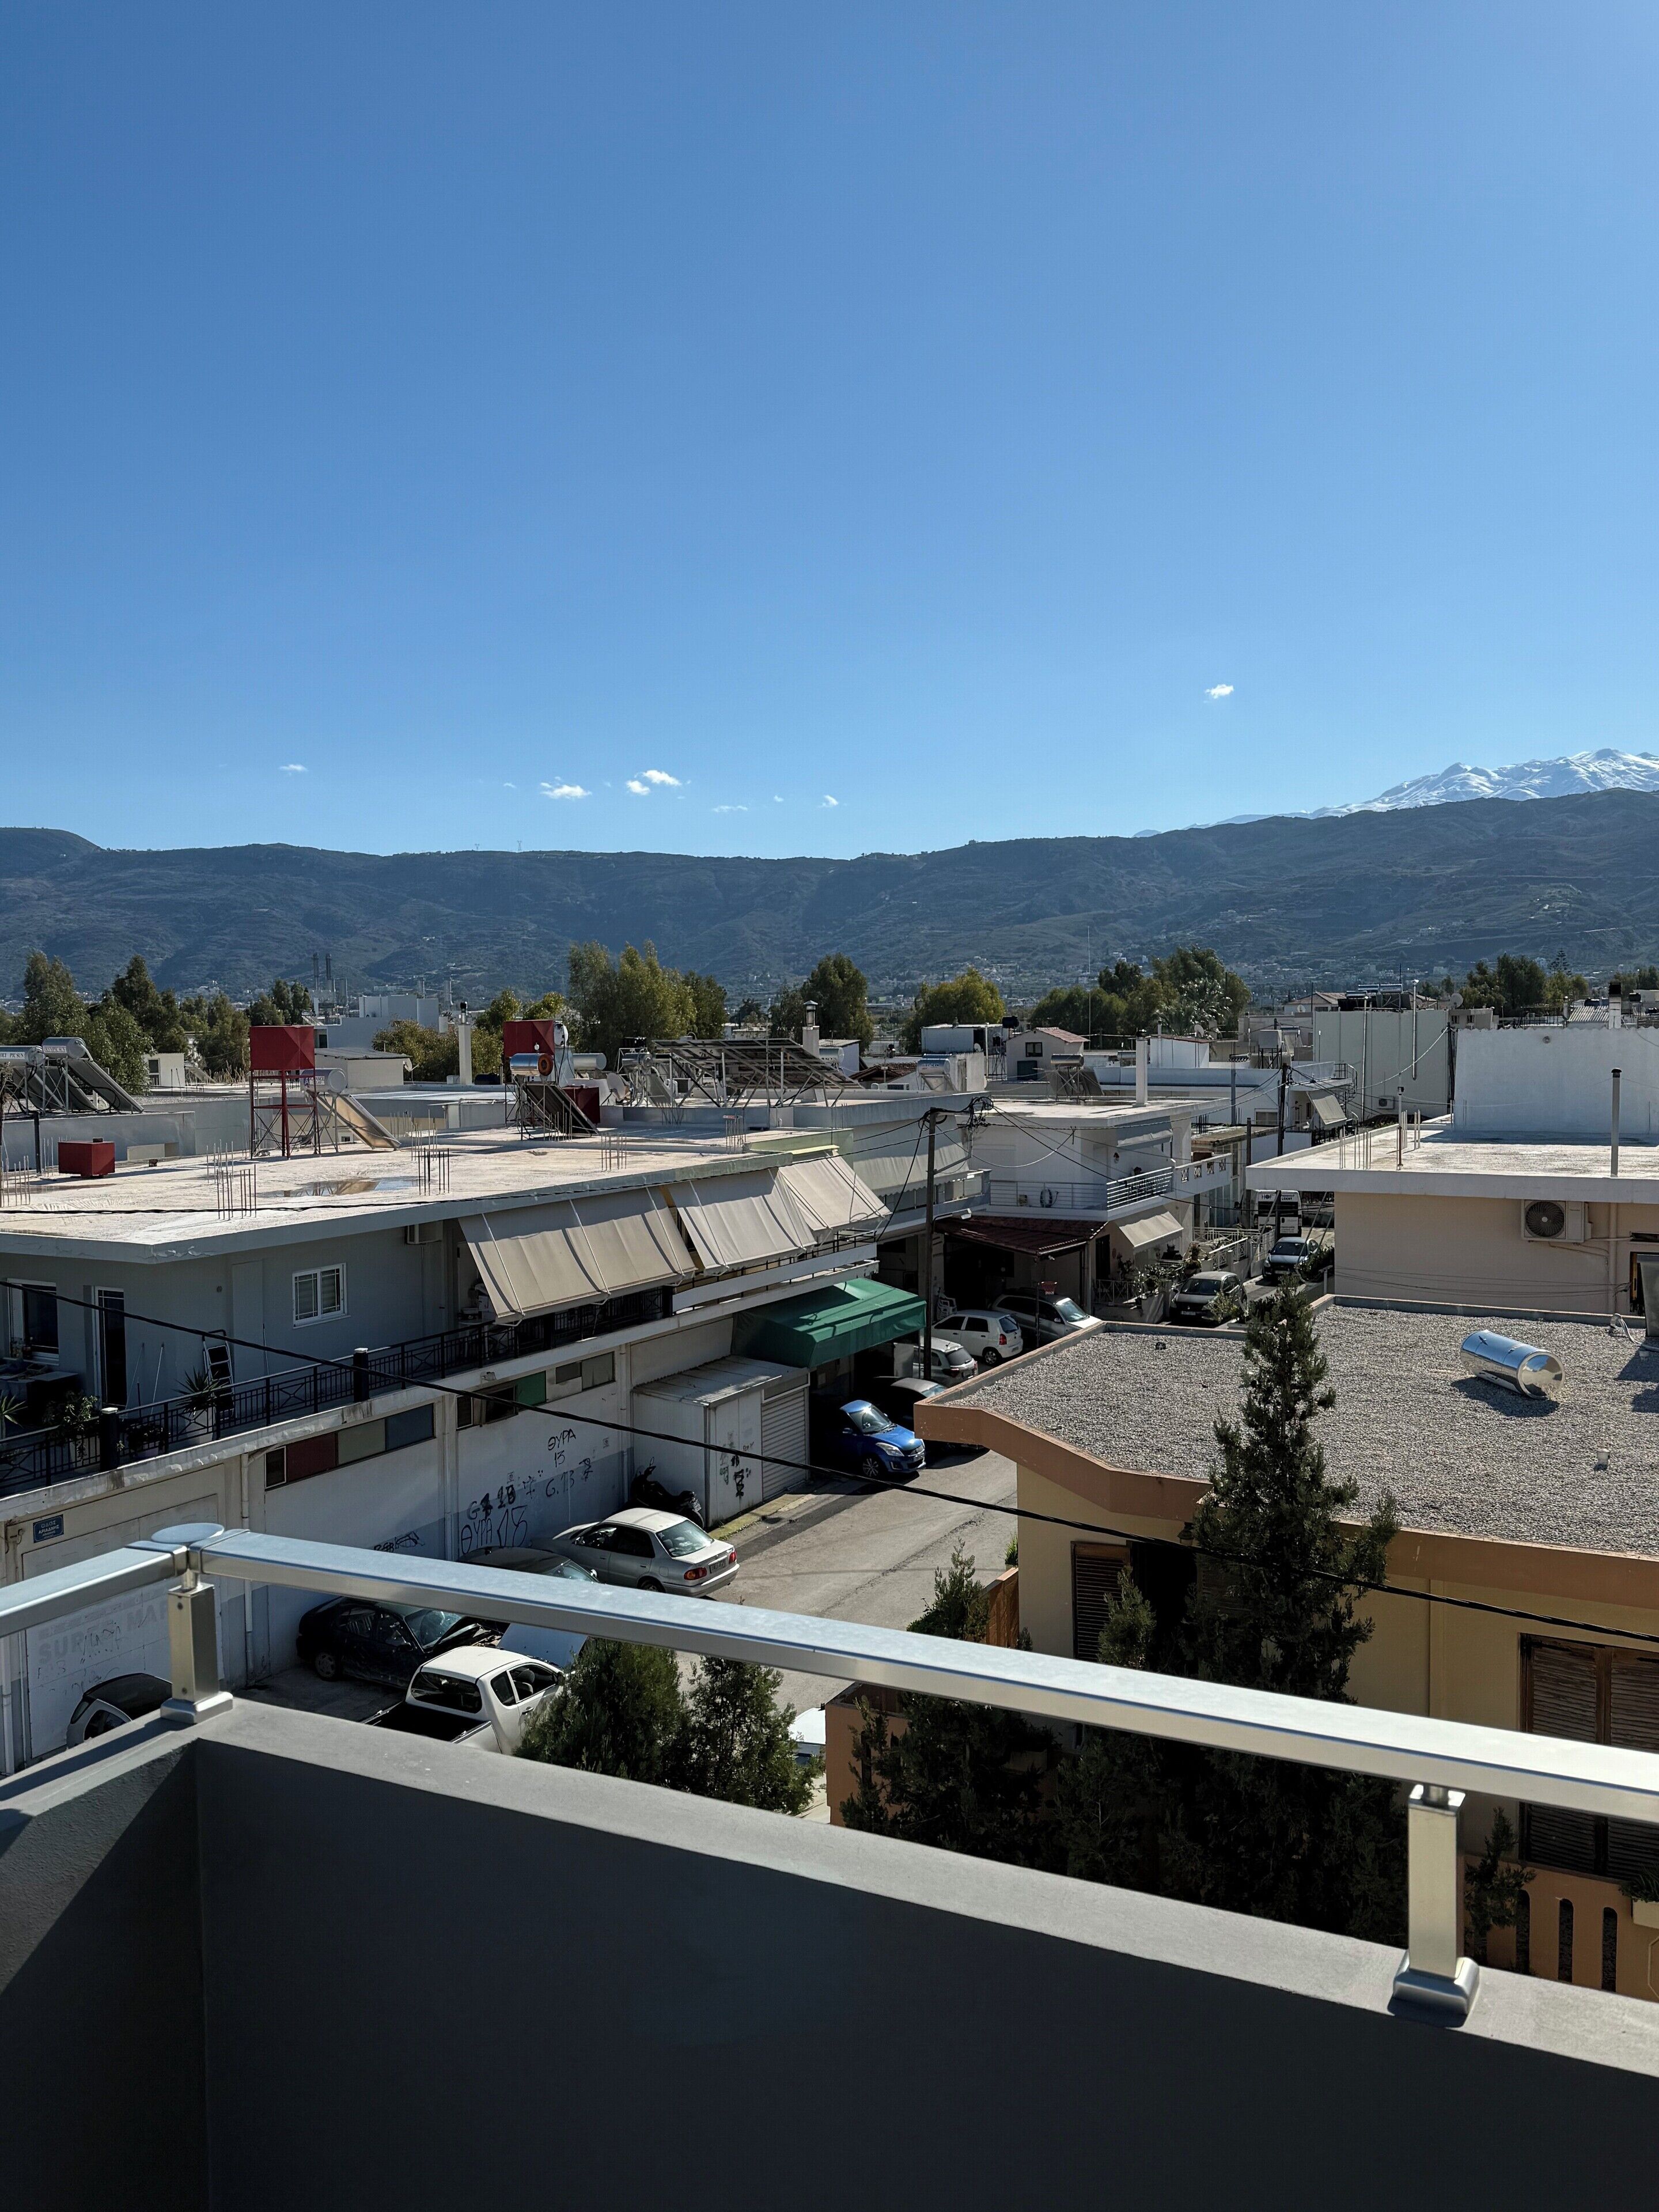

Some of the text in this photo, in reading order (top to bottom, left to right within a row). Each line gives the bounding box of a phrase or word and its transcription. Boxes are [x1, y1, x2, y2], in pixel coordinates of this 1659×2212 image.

[547, 1428, 577, 1451] ΘΥΡΑ
[554, 1449, 565, 1468] 13
[41, 1520, 56, 1528] ΟΔΟΣ
[461, 1518, 493, 1555] ΘΥΡΑ
